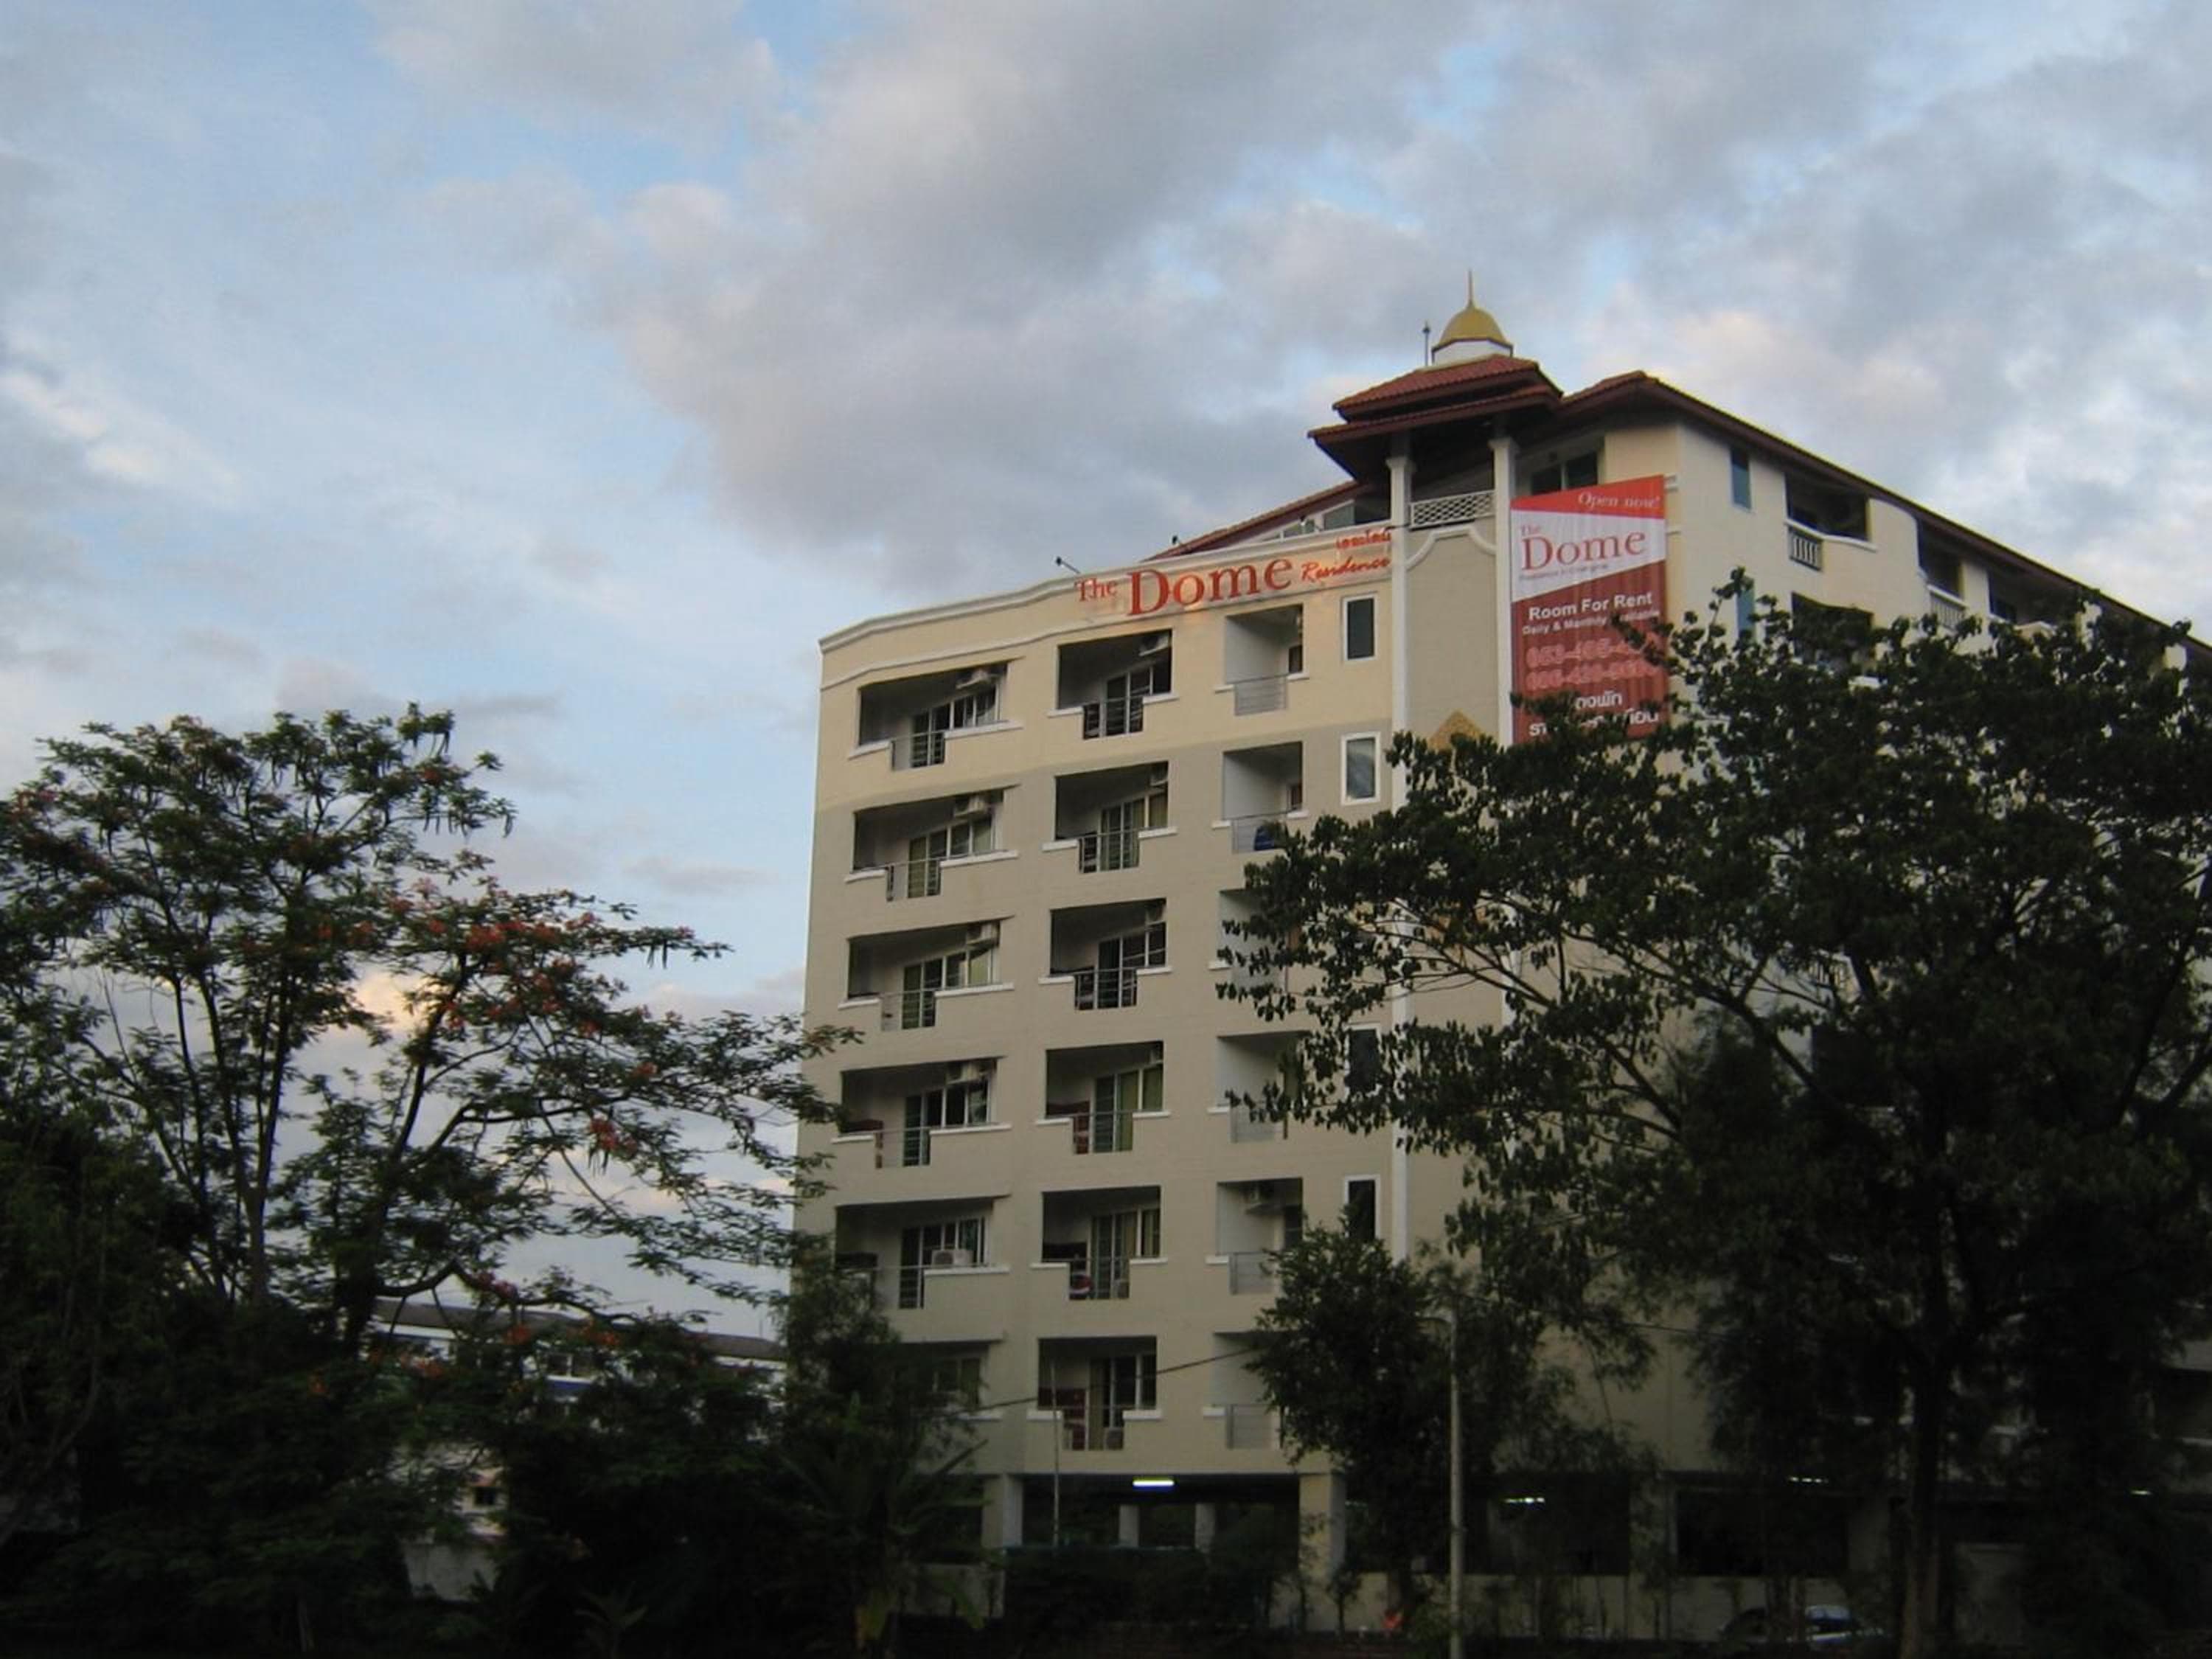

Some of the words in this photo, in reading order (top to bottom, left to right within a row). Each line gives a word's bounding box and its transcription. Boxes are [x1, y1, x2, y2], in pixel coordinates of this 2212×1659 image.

[1579, 492, 1618, 508] Open
[1521, 530, 1646, 571] Dome
[1074, 576, 1118, 602] The
[1127, 557, 1293, 616] Dome
[1301, 554, 1391, 583] Residence
[1528, 604, 1577, 621] Room
[1581, 597, 1610, 612] For
[1613, 591, 1653, 609] Rent
